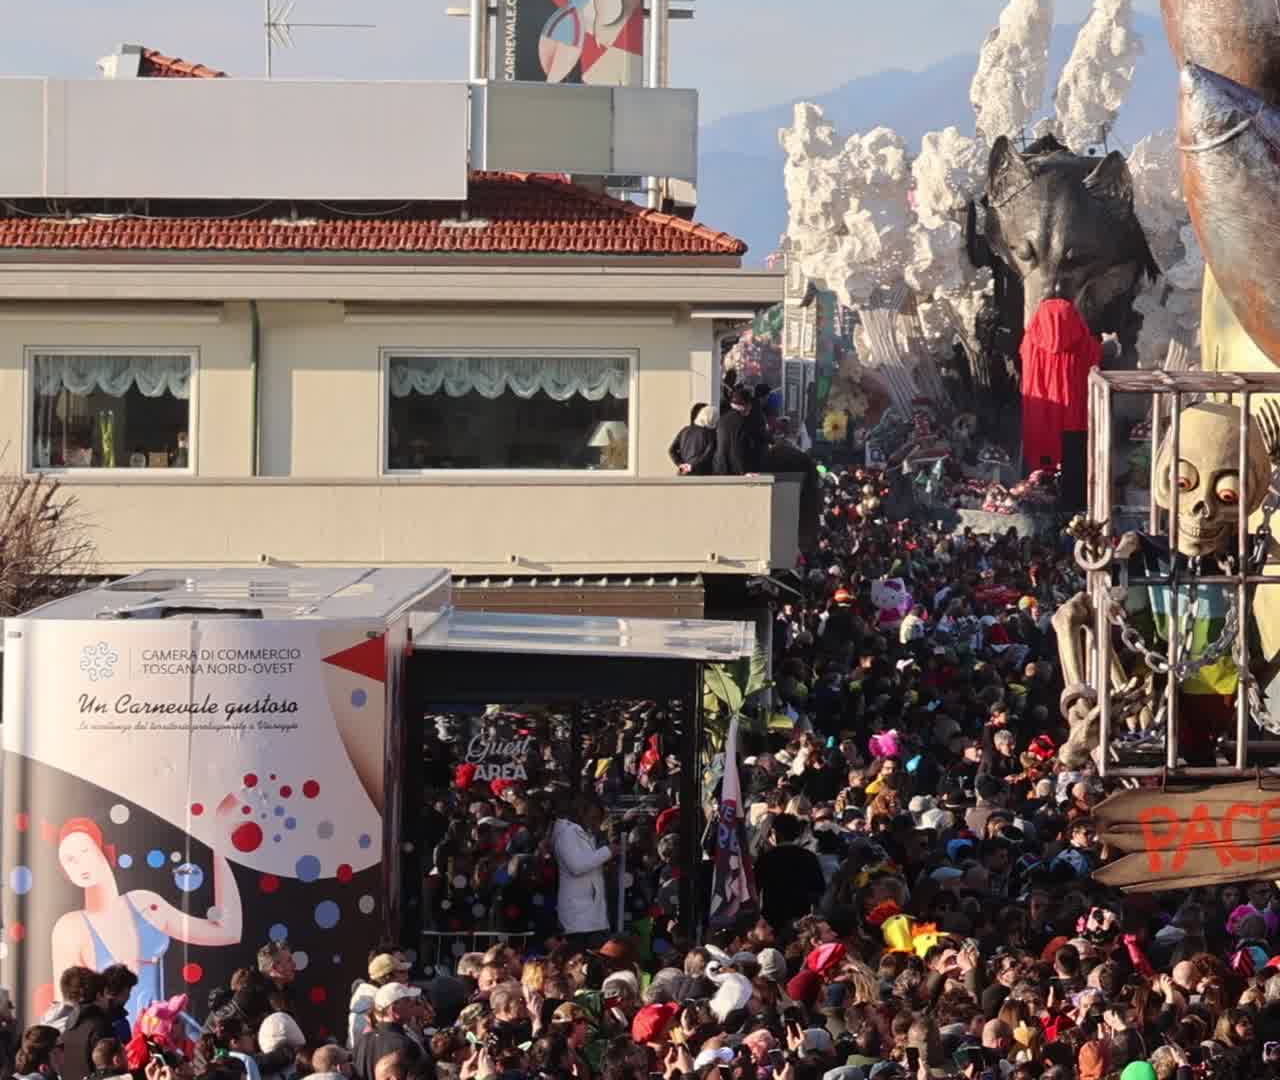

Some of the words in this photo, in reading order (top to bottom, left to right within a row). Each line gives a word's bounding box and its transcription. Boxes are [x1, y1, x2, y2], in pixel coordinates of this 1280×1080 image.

[141, 649, 198, 661] CAMERA
[201, 649, 214, 661] DI
[217, 648, 301, 661] COMMERCIO
[142, 663, 204, 675] TOSCANA
[207, 662, 294, 675] NORD-OVEST
[78, 693, 108, 714] Un
[114, 693, 219, 714] Carnevale
[224, 693, 299, 720] gustoso
[465, 734, 529, 763] Guest
[473, 764, 528, 781] AREA
